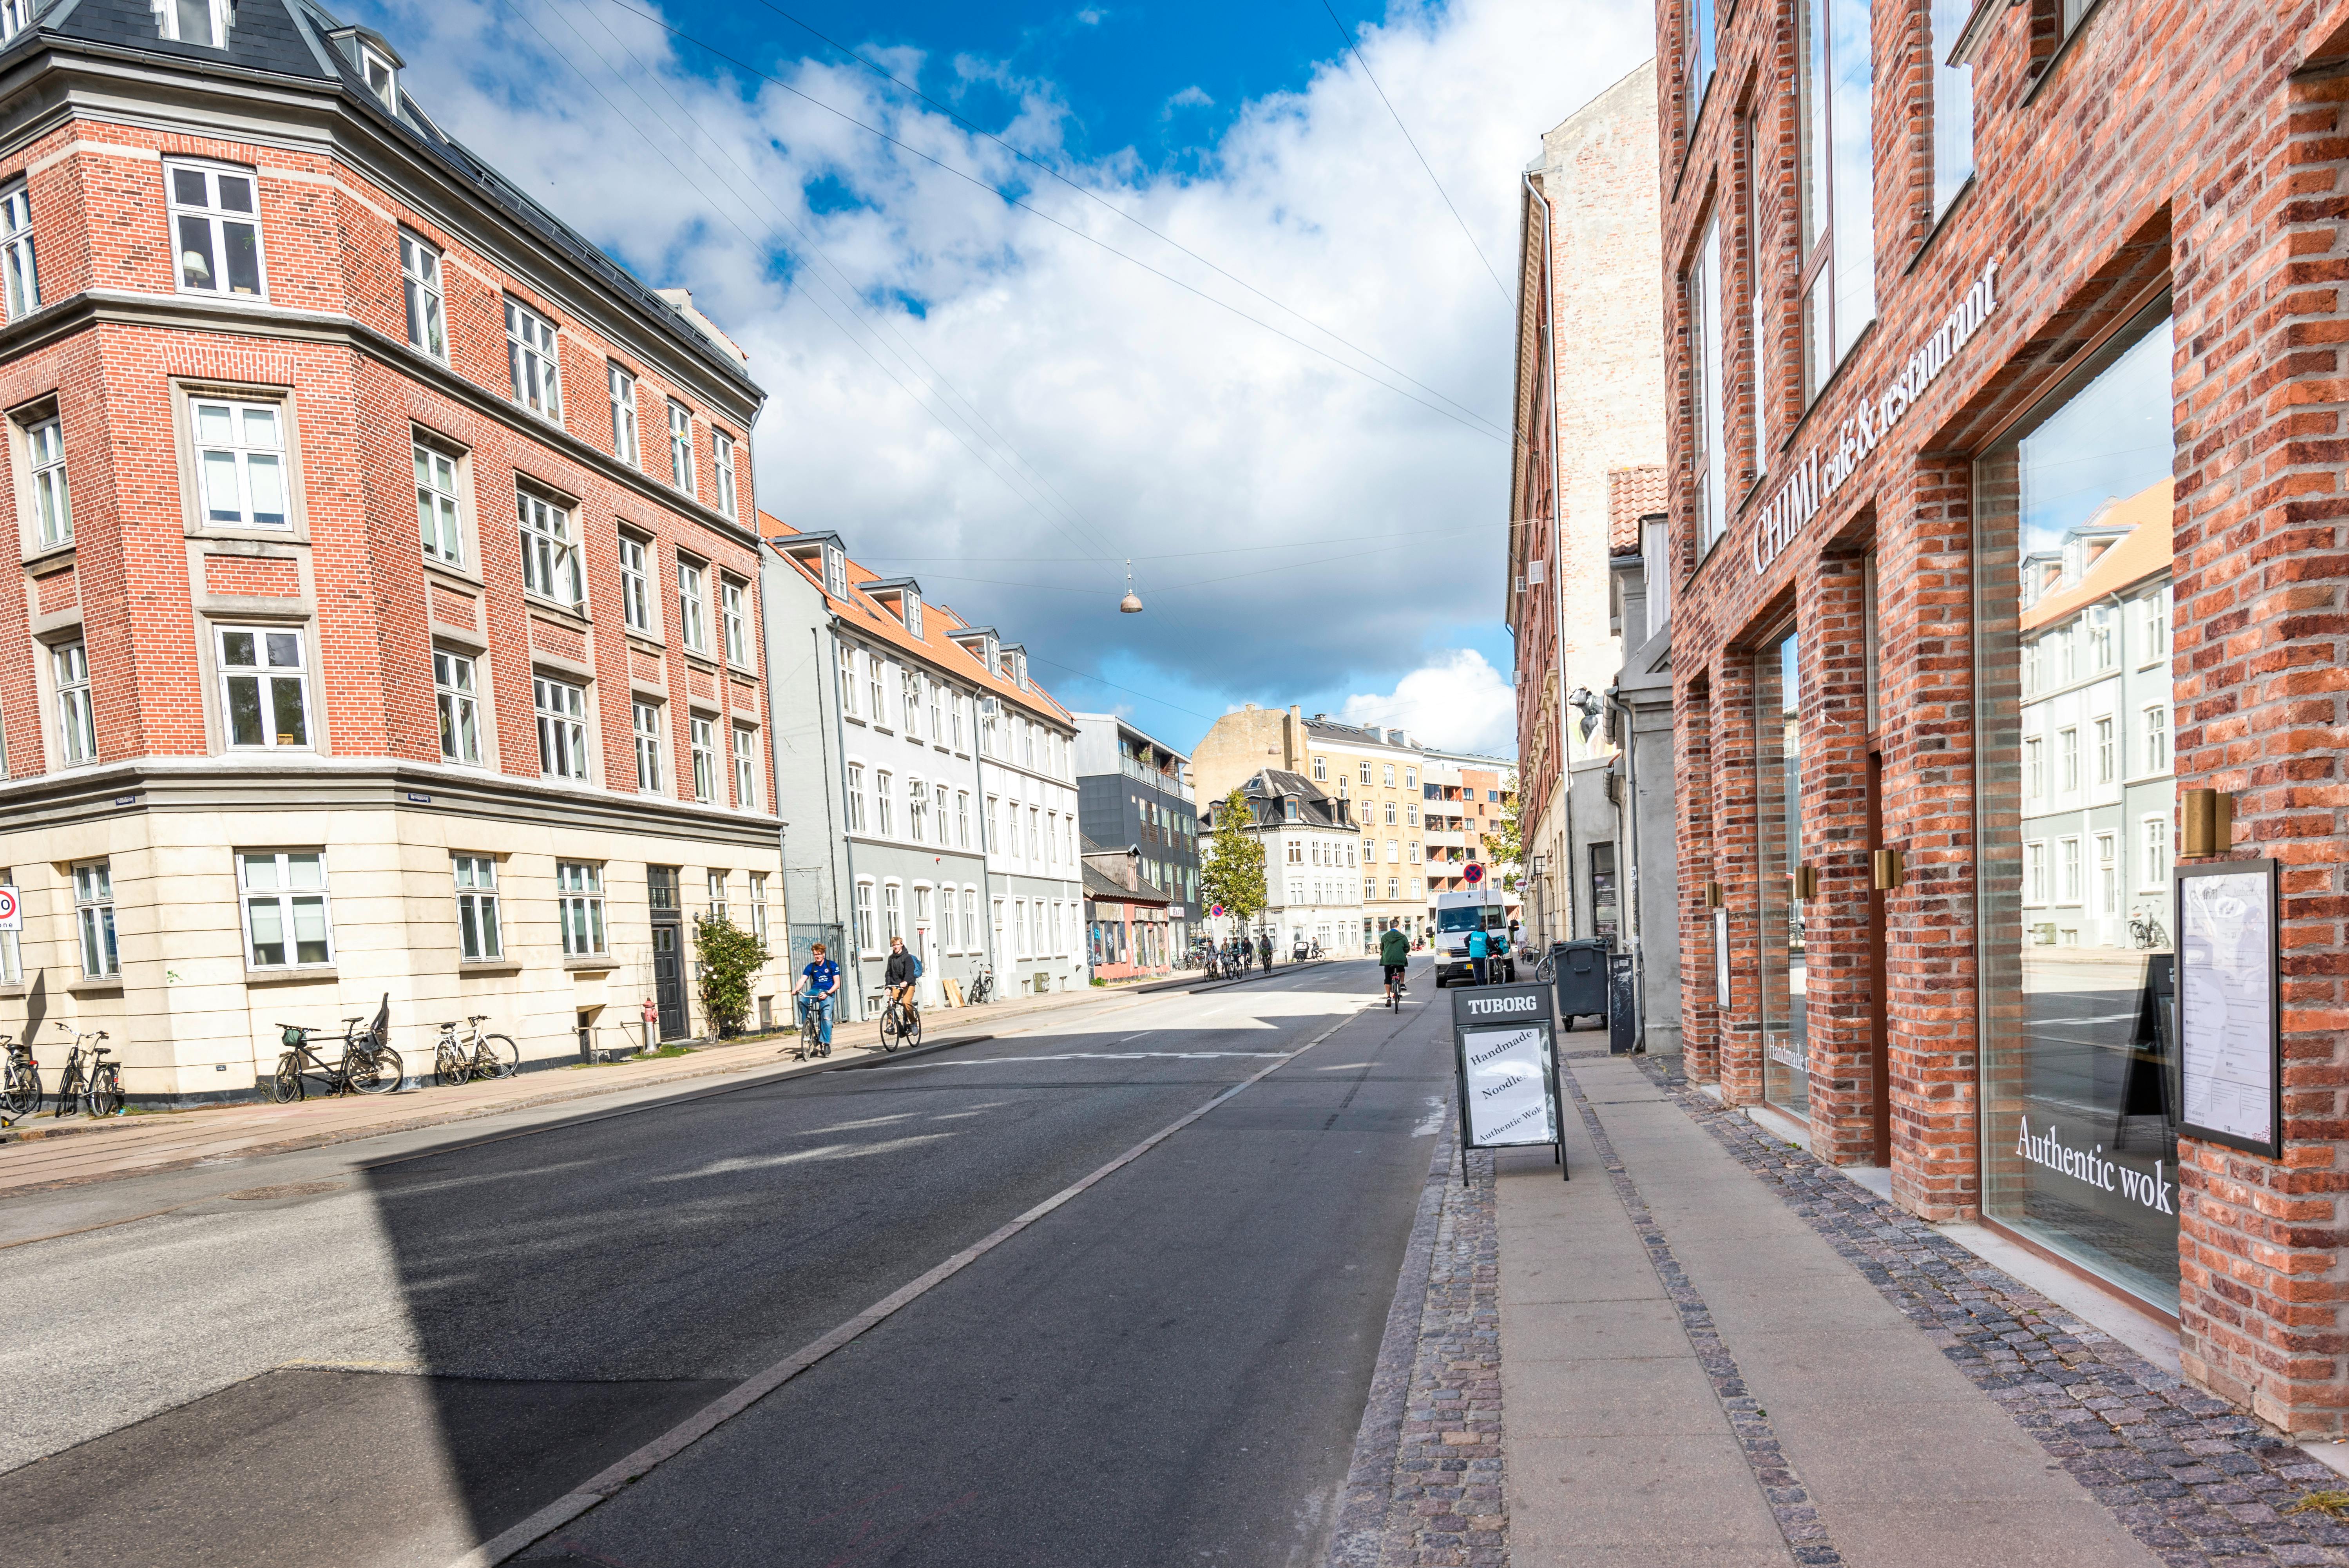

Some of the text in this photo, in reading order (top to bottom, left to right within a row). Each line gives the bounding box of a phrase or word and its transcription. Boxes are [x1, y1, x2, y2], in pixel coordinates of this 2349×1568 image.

[1753, 256, 1999, 574] CHIMI café & restaurant
[0, 899, 10, 910] 0
[1468, 996, 1537, 1014] TUBORG
[1470, 1030, 1533, 1066] Handmade
[1768, 1034, 1804, 1071] Handmade
[1481, 1071, 1529, 1100] Noodles
[1479, 1106, 1543, 1143] Authentic Wok
[2016, 1115, 2173, 1215] Authentic wok
